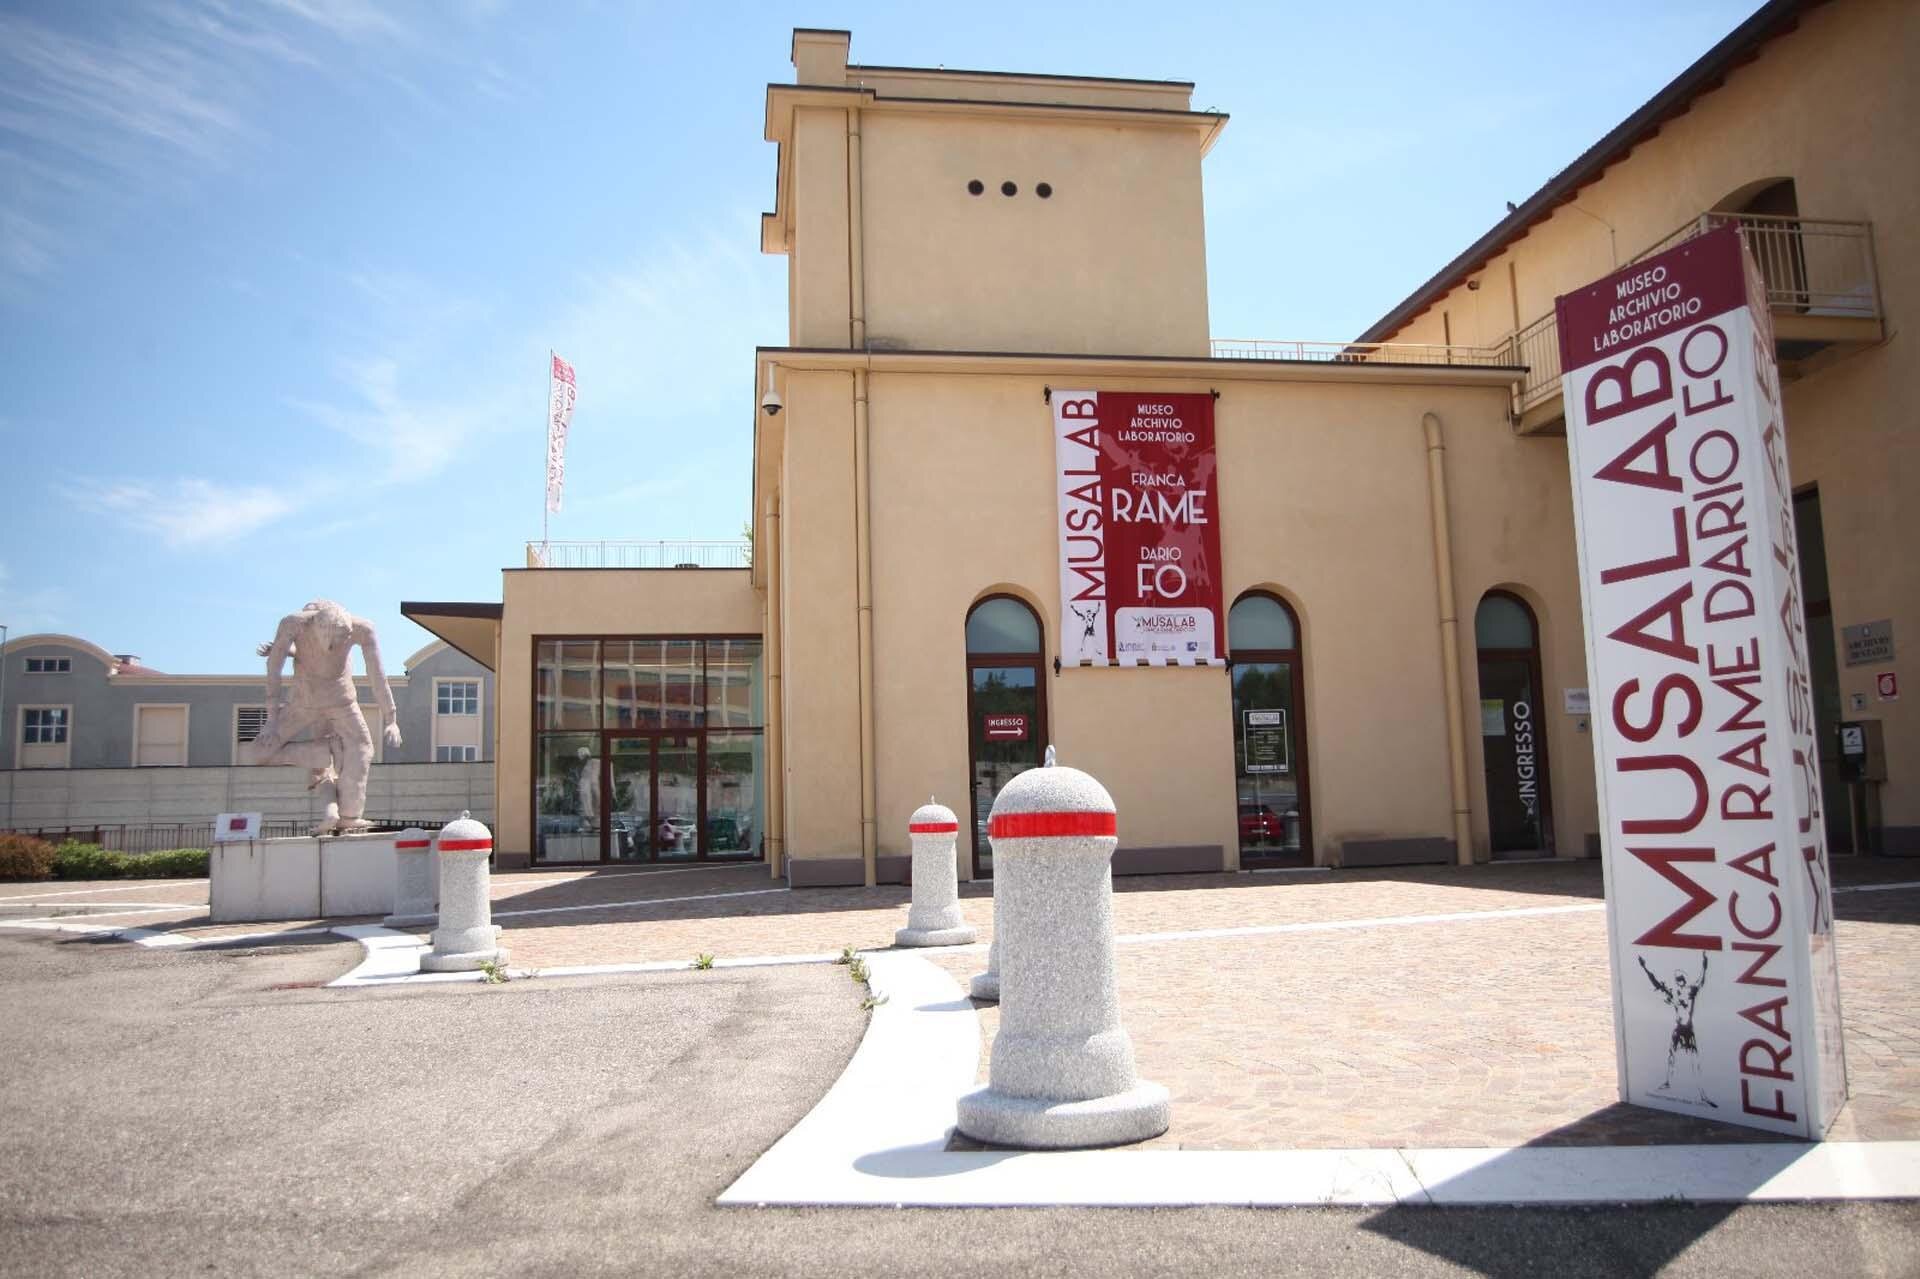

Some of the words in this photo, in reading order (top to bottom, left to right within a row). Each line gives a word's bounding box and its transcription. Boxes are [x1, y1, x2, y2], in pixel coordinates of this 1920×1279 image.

[1616, 266, 1666, 299] MUSEO
[1608, 283, 1681, 325] ARCHIVIO
[1594, 297, 1701, 352] LABORATORIO
[1679, 324, 1735, 417] FO
[1130, 418, 1183, 430] ARCHIVIO
[1137, 404, 1174, 415] MUSEO
[1118, 430, 1195, 444] LABORATORIO
[1131, 472, 1185, 487] FRANCA
[1061, 398, 1107, 602] MUSALAB
[1112, 487, 1208, 525] RAME
[1689, 429, 1756, 624] DARIO
[1140, 546, 1182, 561] DARIO
[1136, 563, 1187, 599] FO
[1142, 616, 1196, 627] MUSALAB
[1584, 346, 1723, 952] MUSALAB
[988, 718, 1024, 727] INGRESSO
[1707, 636, 1774, 821] RAME
[1513, 701, 1537, 800] INGRESSO
[1725, 841, 1798, 1123] FRANCA
